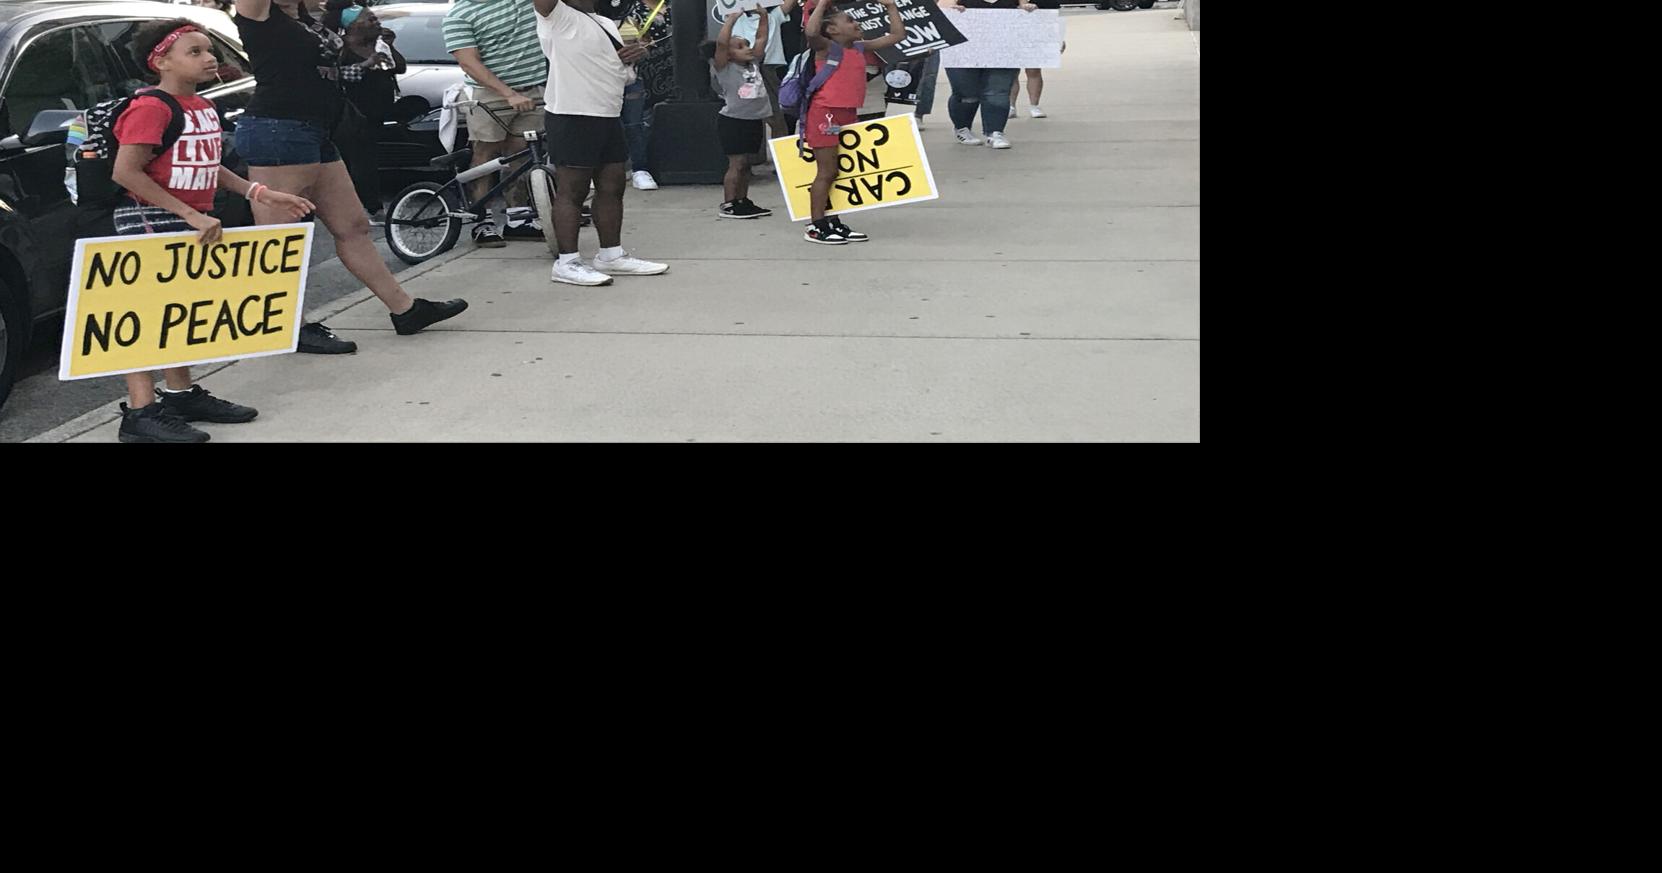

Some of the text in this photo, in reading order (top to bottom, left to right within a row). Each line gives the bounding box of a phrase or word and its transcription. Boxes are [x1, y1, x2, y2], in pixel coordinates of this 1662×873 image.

[844, 0, 913, 19] THE SYEM
[885, 6, 930, 24] CANGE
[808, 171, 911, 210] CAR
[85, 234, 304, 289] NO JUSTICE
[82, 291, 287, 356] NO PEACE
